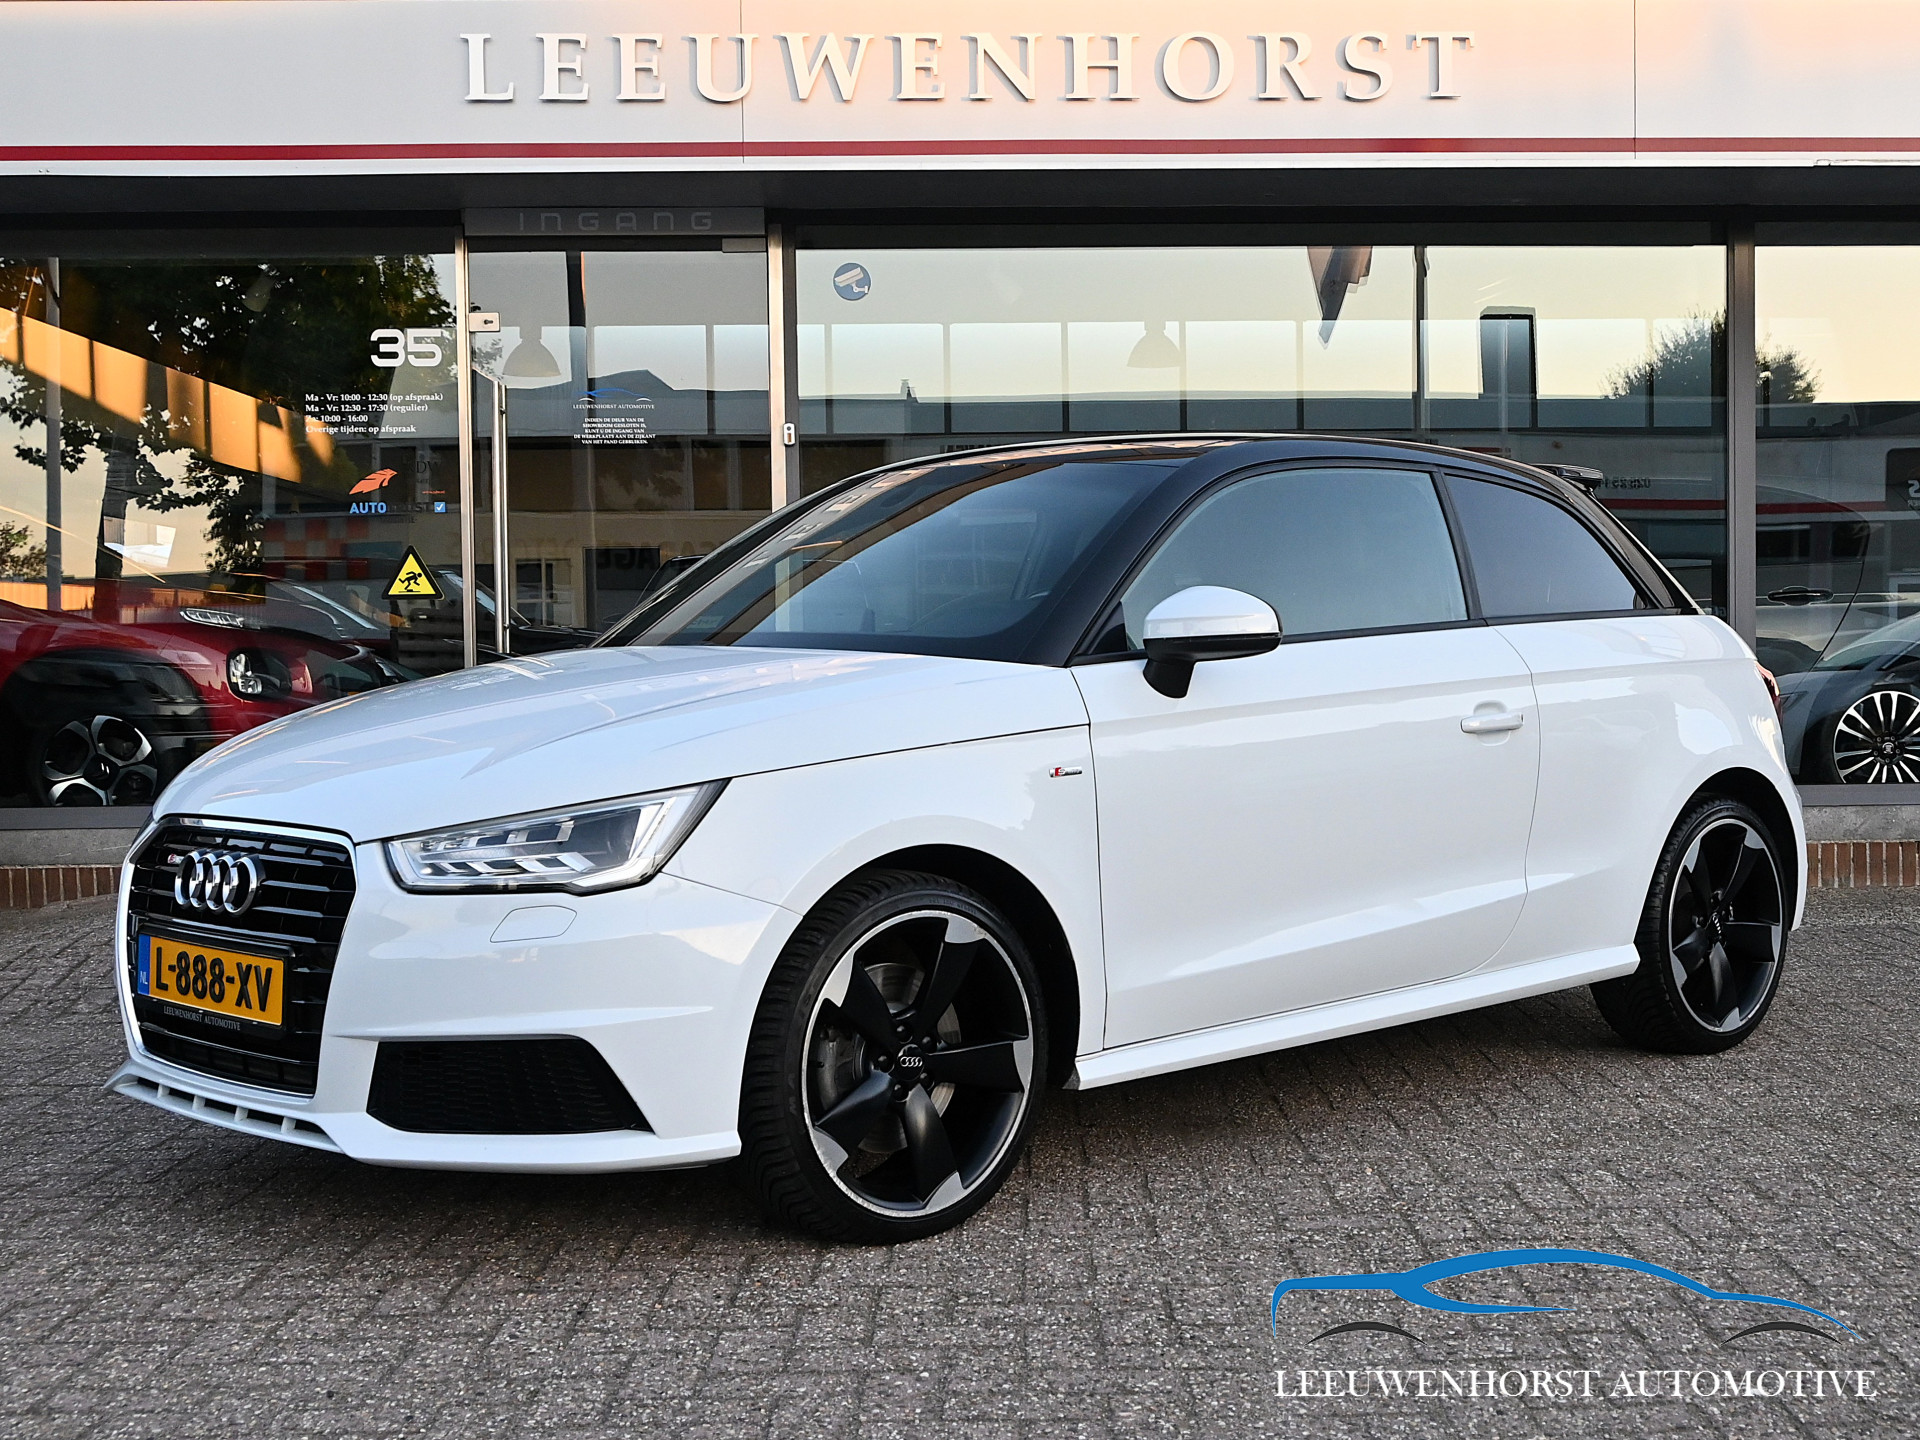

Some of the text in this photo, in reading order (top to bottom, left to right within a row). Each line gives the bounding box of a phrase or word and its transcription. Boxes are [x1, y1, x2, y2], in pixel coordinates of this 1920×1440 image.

[458, 31, 1476, 102] LEEUWENHORST
[519, 212, 712, 231] INGANG
[370, 328, 443, 367] 35
[305, 394, 319, 402] Ma
[340, 394, 361, 402] 10:00
[367, 394, 388, 402] 12:30
[390, 393, 404, 403] (op
[405, 393, 443, 403] afspraak)
[305, 404, 319, 412] Ma
[340, 404, 361, 412] 12:30
[368, 404, 388, 412] 17:30
[390, 404, 428, 413] (regulier)
[305, 425, 339, 434] Overige
[340, 425, 366, 433] tijden:
[381, 425, 416, 433] afspraak
[140, 971, 148, 985] NL
[156, 946, 273, 1012] L-888-XV
[163, 1005, 241, 1031] LEEUWENHORST AUTOMOTIVE
